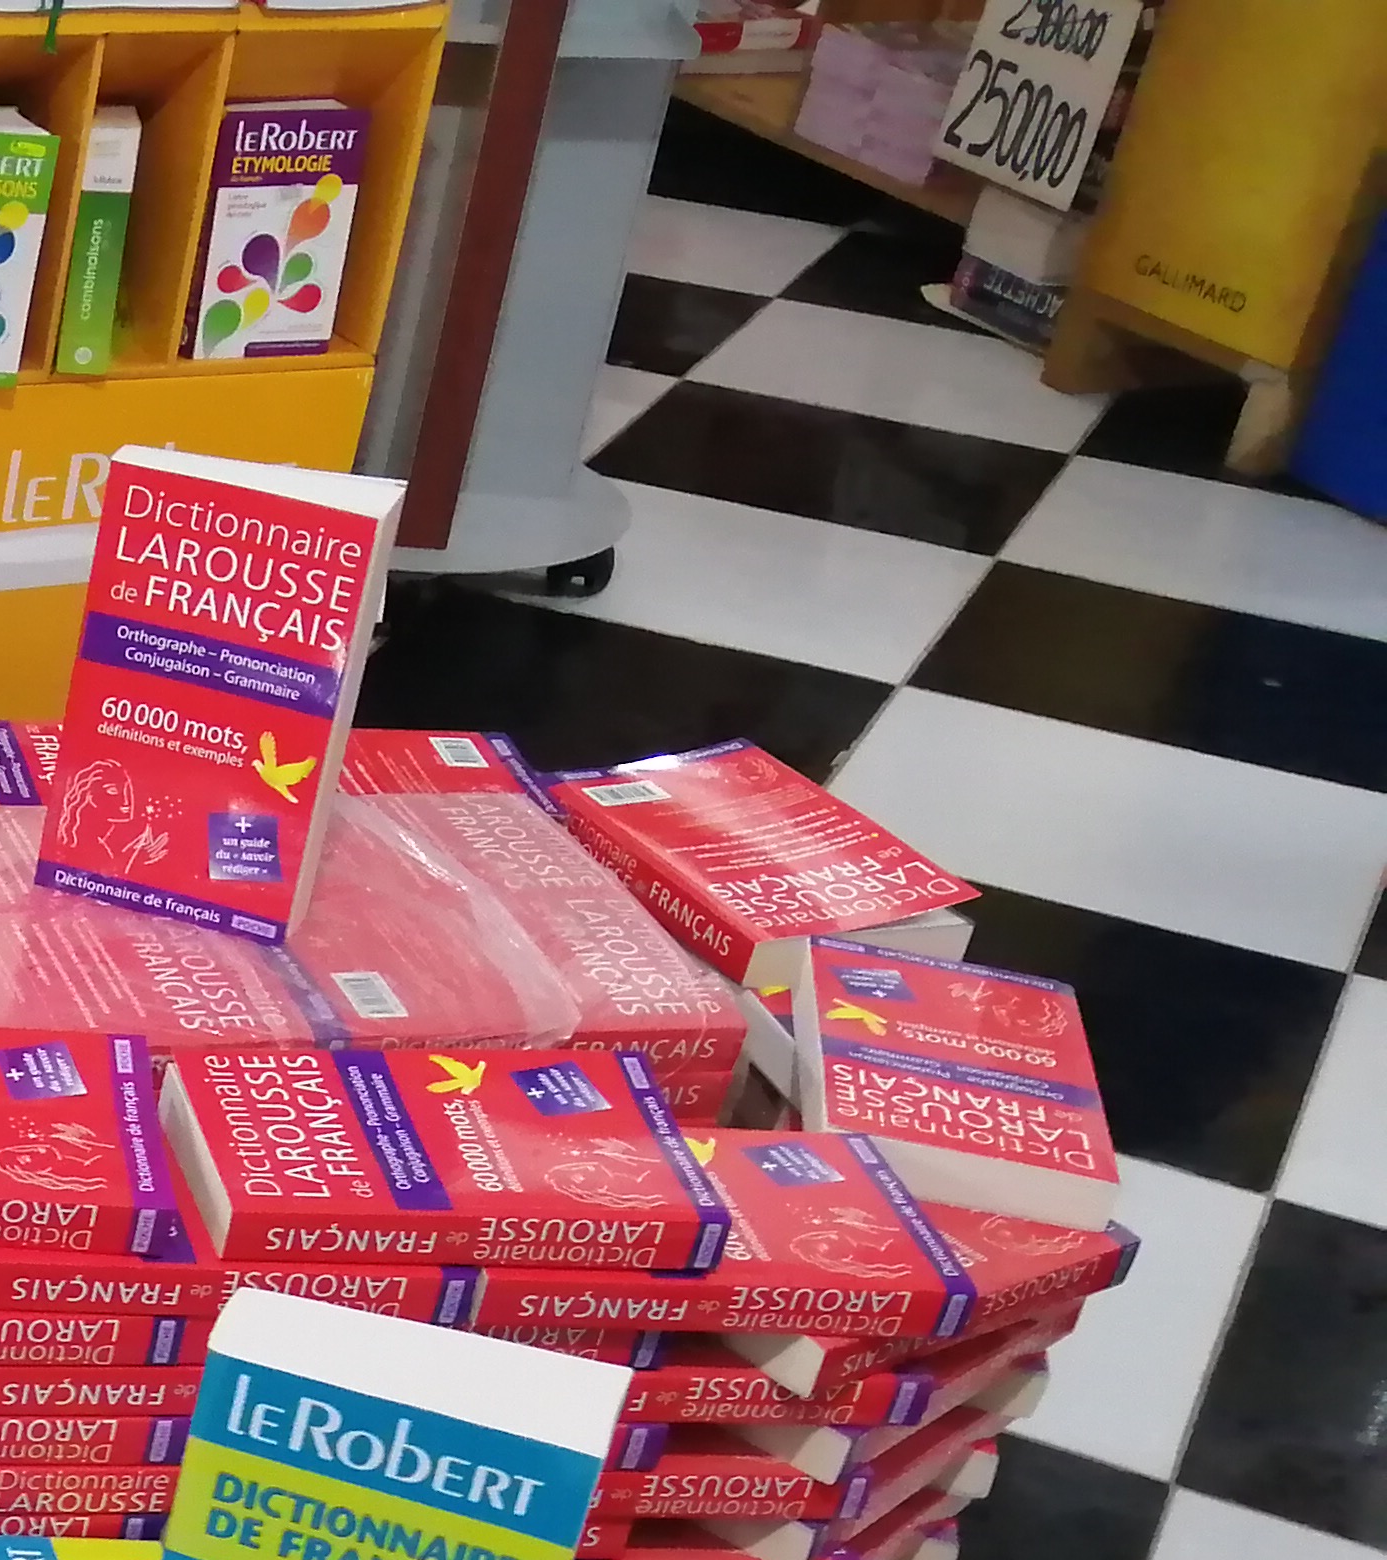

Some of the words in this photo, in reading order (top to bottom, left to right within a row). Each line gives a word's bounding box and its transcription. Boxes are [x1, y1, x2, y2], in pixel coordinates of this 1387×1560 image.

[944, 51, 1087, 188] 2500,00
[79, 217, 104, 321] combinaisons
[1134, 254, 1247, 314] GALLIMARD
[123, 484, 363, 569] Dictionnaire
[115, 532, 355, 614] LAROUSSE
[110, 581, 140, 603] de
[143, 574, 347, 652] FRANÇAIS
[116, 624, 206, 661] Orthographe
[219, 648, 315, 686] Prononciation
[125, 646, 211, 678] Conjugaison
[223, 668, 301, 702] Grammaire
[97, 722, 165, 750] définitions
[167, 736, 181, 752] et
[181, 739, 244, 770] exemples
[182, 720, 248, 754] mots,
[241, 837, 271, 851] guide
[54, 869, 141, 904] Dictionnaire
[143, 890, 163, 908] de
[165, 895, 221, 925] français
[647, 881, 733, 957] FRANÇAIS
[204, 1055, 283, 1197] Dictionnaire
[238, 1054, 331, 1199] LAROUSSE
[283, 1053, 359, 1192] FRANÇAIS
[832, 1063, 1048, 1122] FRANÇAIS
[837, 1084, 1090, 1154] LAROUSSE
[836, 1100, 1095, 1172] Dictionnaire
[265, 1228, 437, 1254] FRANÇAIS
[206, 1509, 269, 1549] DE
